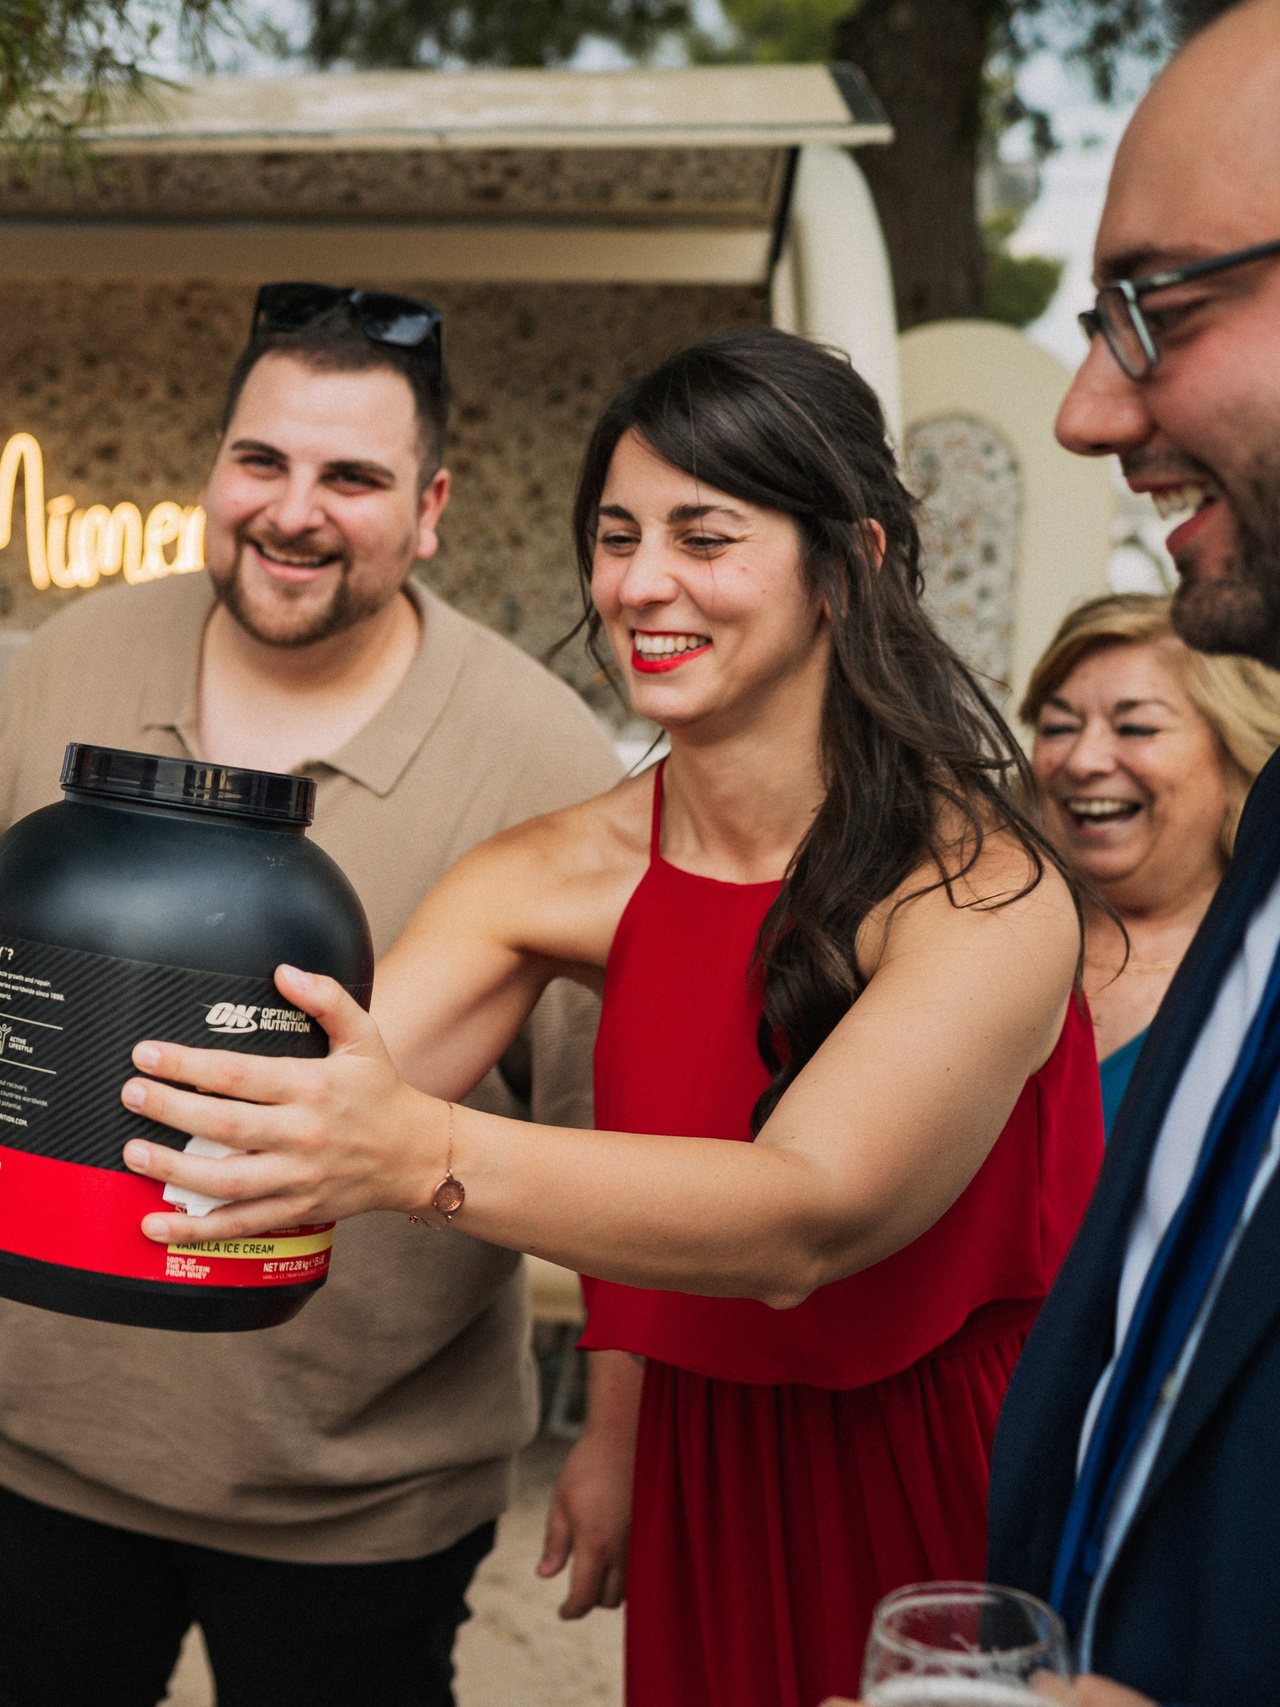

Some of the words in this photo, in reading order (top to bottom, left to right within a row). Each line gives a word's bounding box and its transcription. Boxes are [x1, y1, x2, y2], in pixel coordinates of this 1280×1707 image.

[8, 972, 24, 980] growth
[25, 976, 34, 984] and
[11, 984, 35, 995] worldwide
[35, 989, 50, 998] since
[204, 1002, 258, 1031] ON
[261, 1007, 306, 1021] OPTIMUM
[260, 1019, 311, 1032] NUTRITION
[10, 1036, 27, 1044] ACTIVE
[8, 1042, 34, 1053] LIFESTYLE
[0, 1088, 22, 1099] countries
[176, 1241, 220, 1253] VANILLA
[223, 1243, 240, 1253] ICE
[242, 1243, 275, 1253] CREAM
[166, 1256, 186, 1264] 100%
[186, 1257, 197, 1265] OF
[166, 1262, 180, 1270] THE
[181, 1264, 211, 1273] PROTEIN
[262, 1261, 279, 1272] NET
[279, 1261, 290, 1271] WT
[165, 1269, 186, 1278] FROM
[186, 1270, 208, 1279] WHEY
